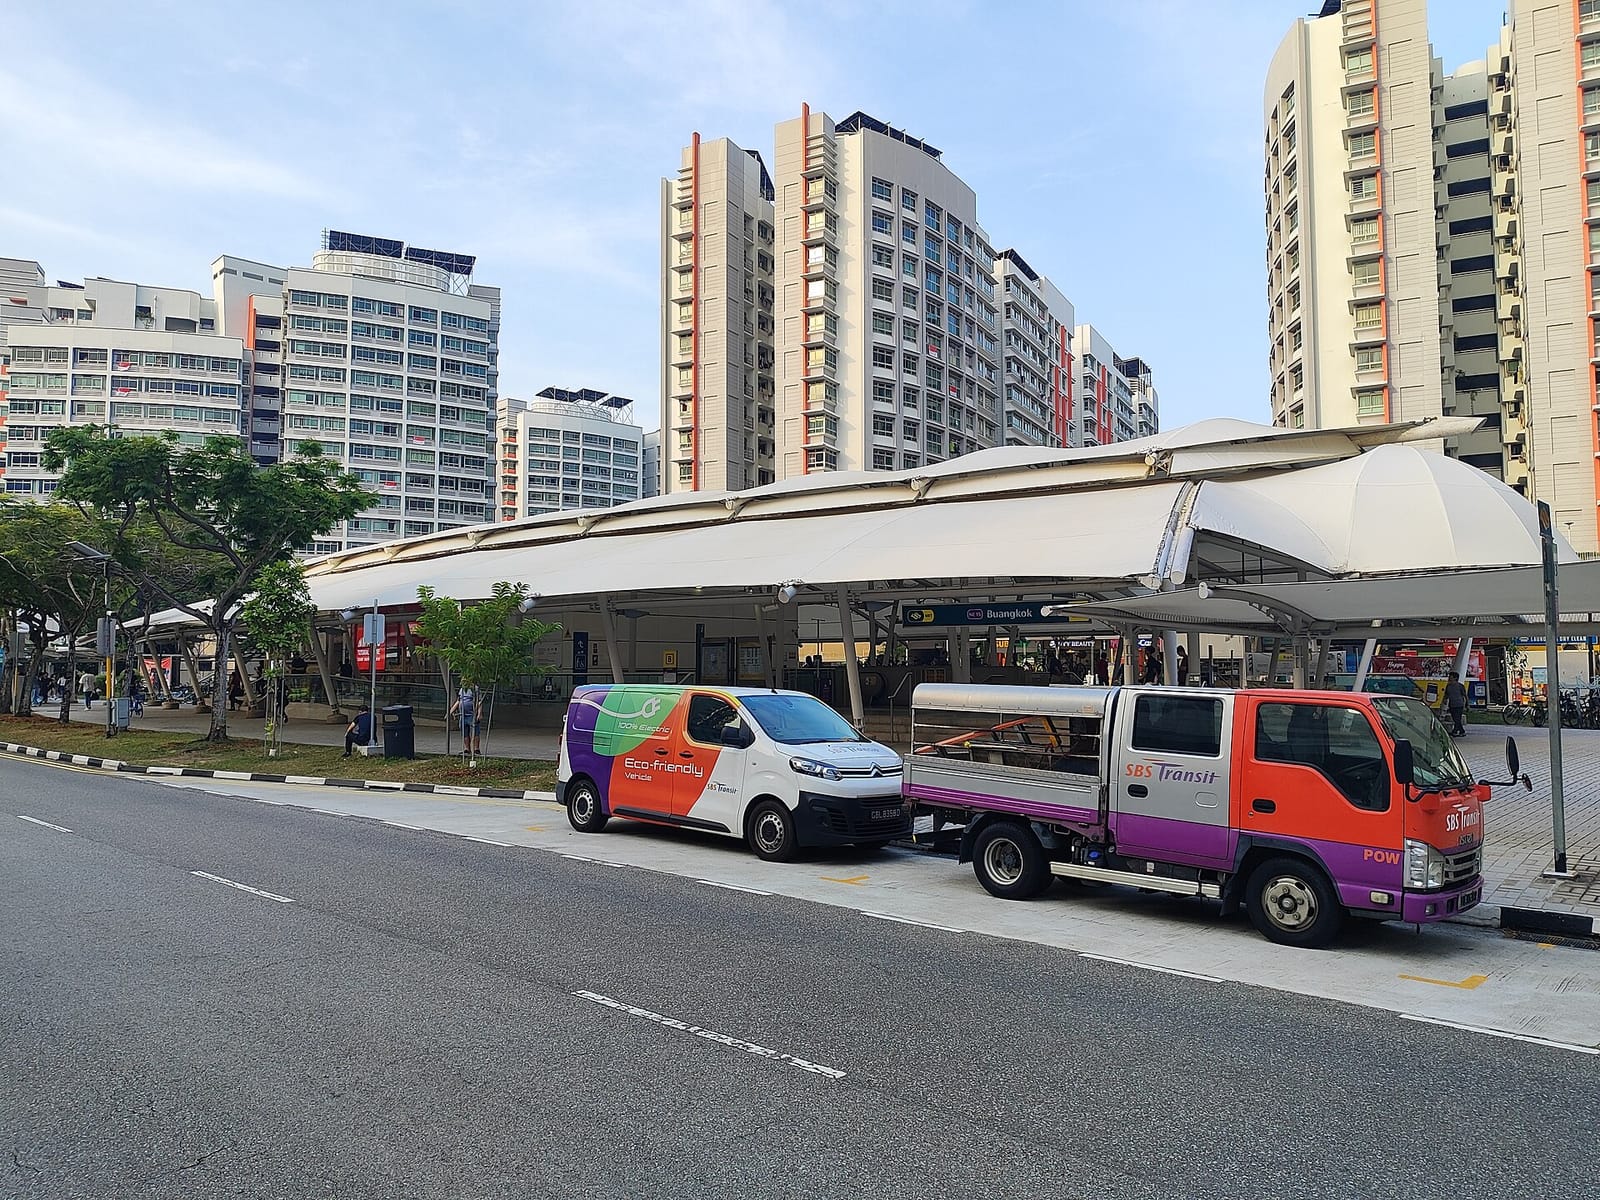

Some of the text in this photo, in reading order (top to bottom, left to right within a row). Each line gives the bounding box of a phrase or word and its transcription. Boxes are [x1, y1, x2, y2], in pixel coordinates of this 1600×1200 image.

[986, 608, 1033, 620] Buangkok
[618, 722, 671, 734] 100% Electric
[624, 757, 704, 778] Eco-friendly
[1125, 762, 1222, 784] SBS Transit
[624, 772, 653, 782] Vehicle
[706, 782, 738, 795] SBS Transit
[1446, 813, 1459, 832] SBS
[1363, 848, 1401, 865] POW
